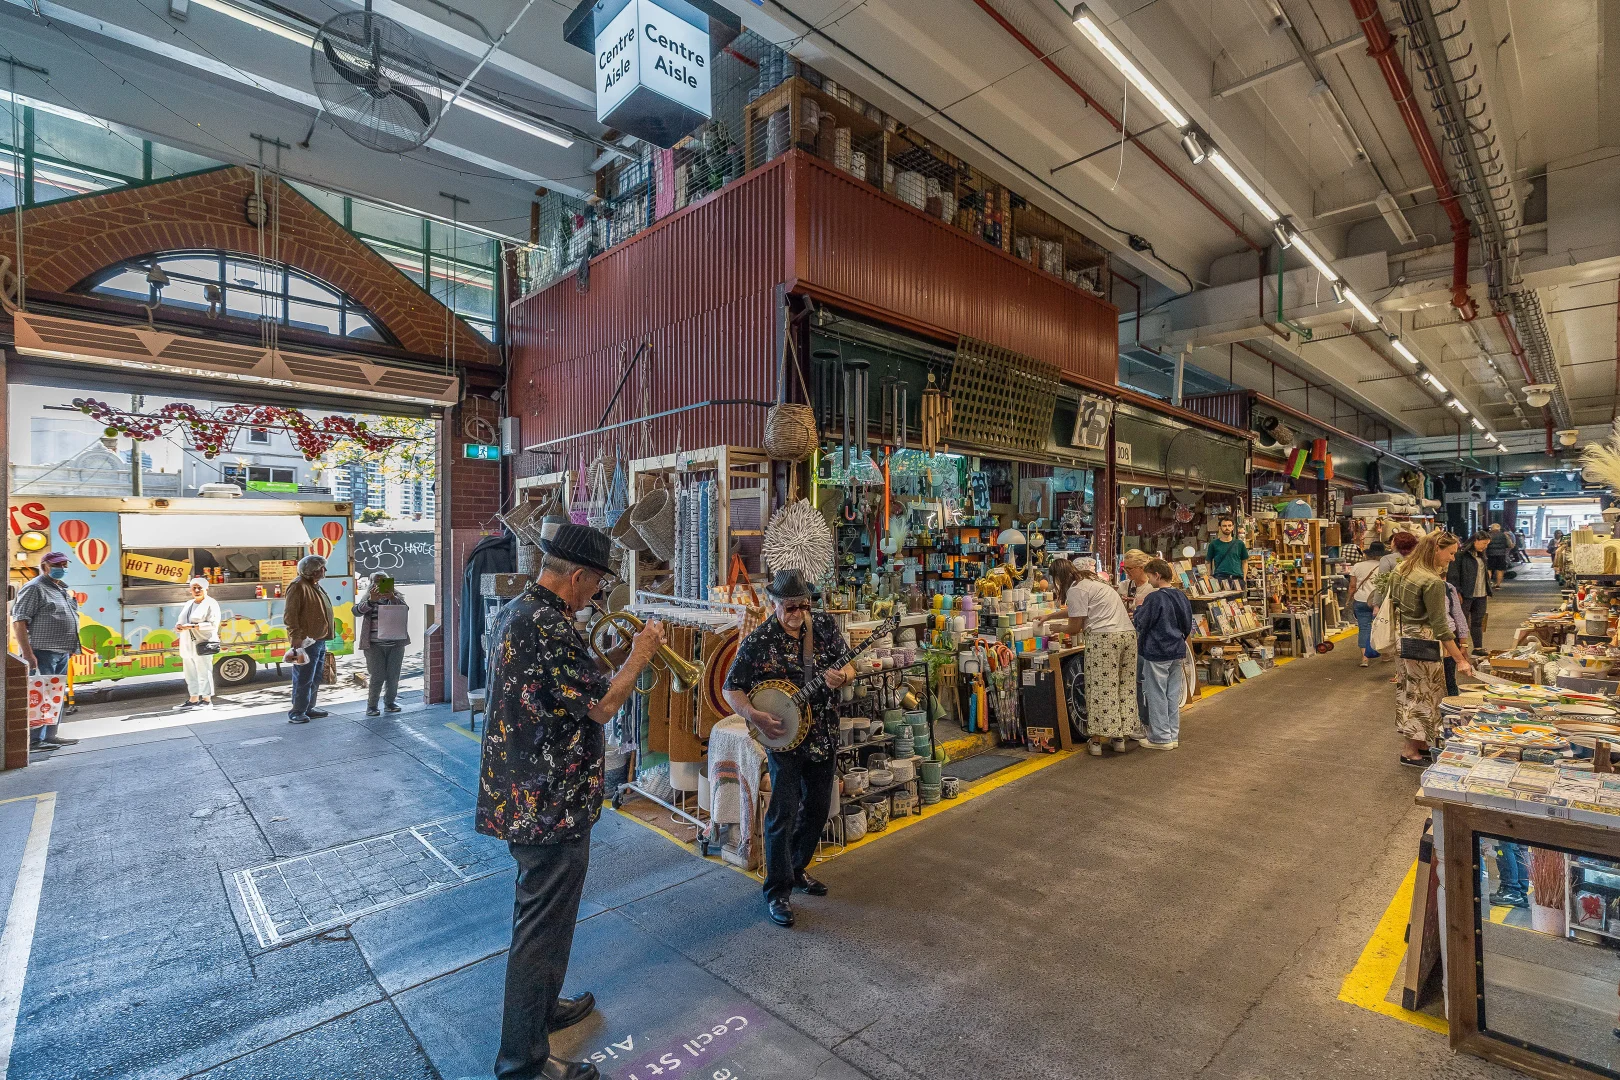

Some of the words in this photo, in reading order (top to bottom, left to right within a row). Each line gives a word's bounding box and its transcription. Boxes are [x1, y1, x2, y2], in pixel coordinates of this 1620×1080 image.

[599, 27, 635, 70] Centre
[645, 24, 705, 68] Centre
[604, 58, 631, 93] Aisle
[654, 55, 698, 89] Aisle
[1117, 446, 1130, 460] 108
[126, 558, 153, 573] HOT
[155, 563, 184, 578] DOGS
[682, 1015, 749, 1057] Cecil
[645, 1052, 681, 1075] St
